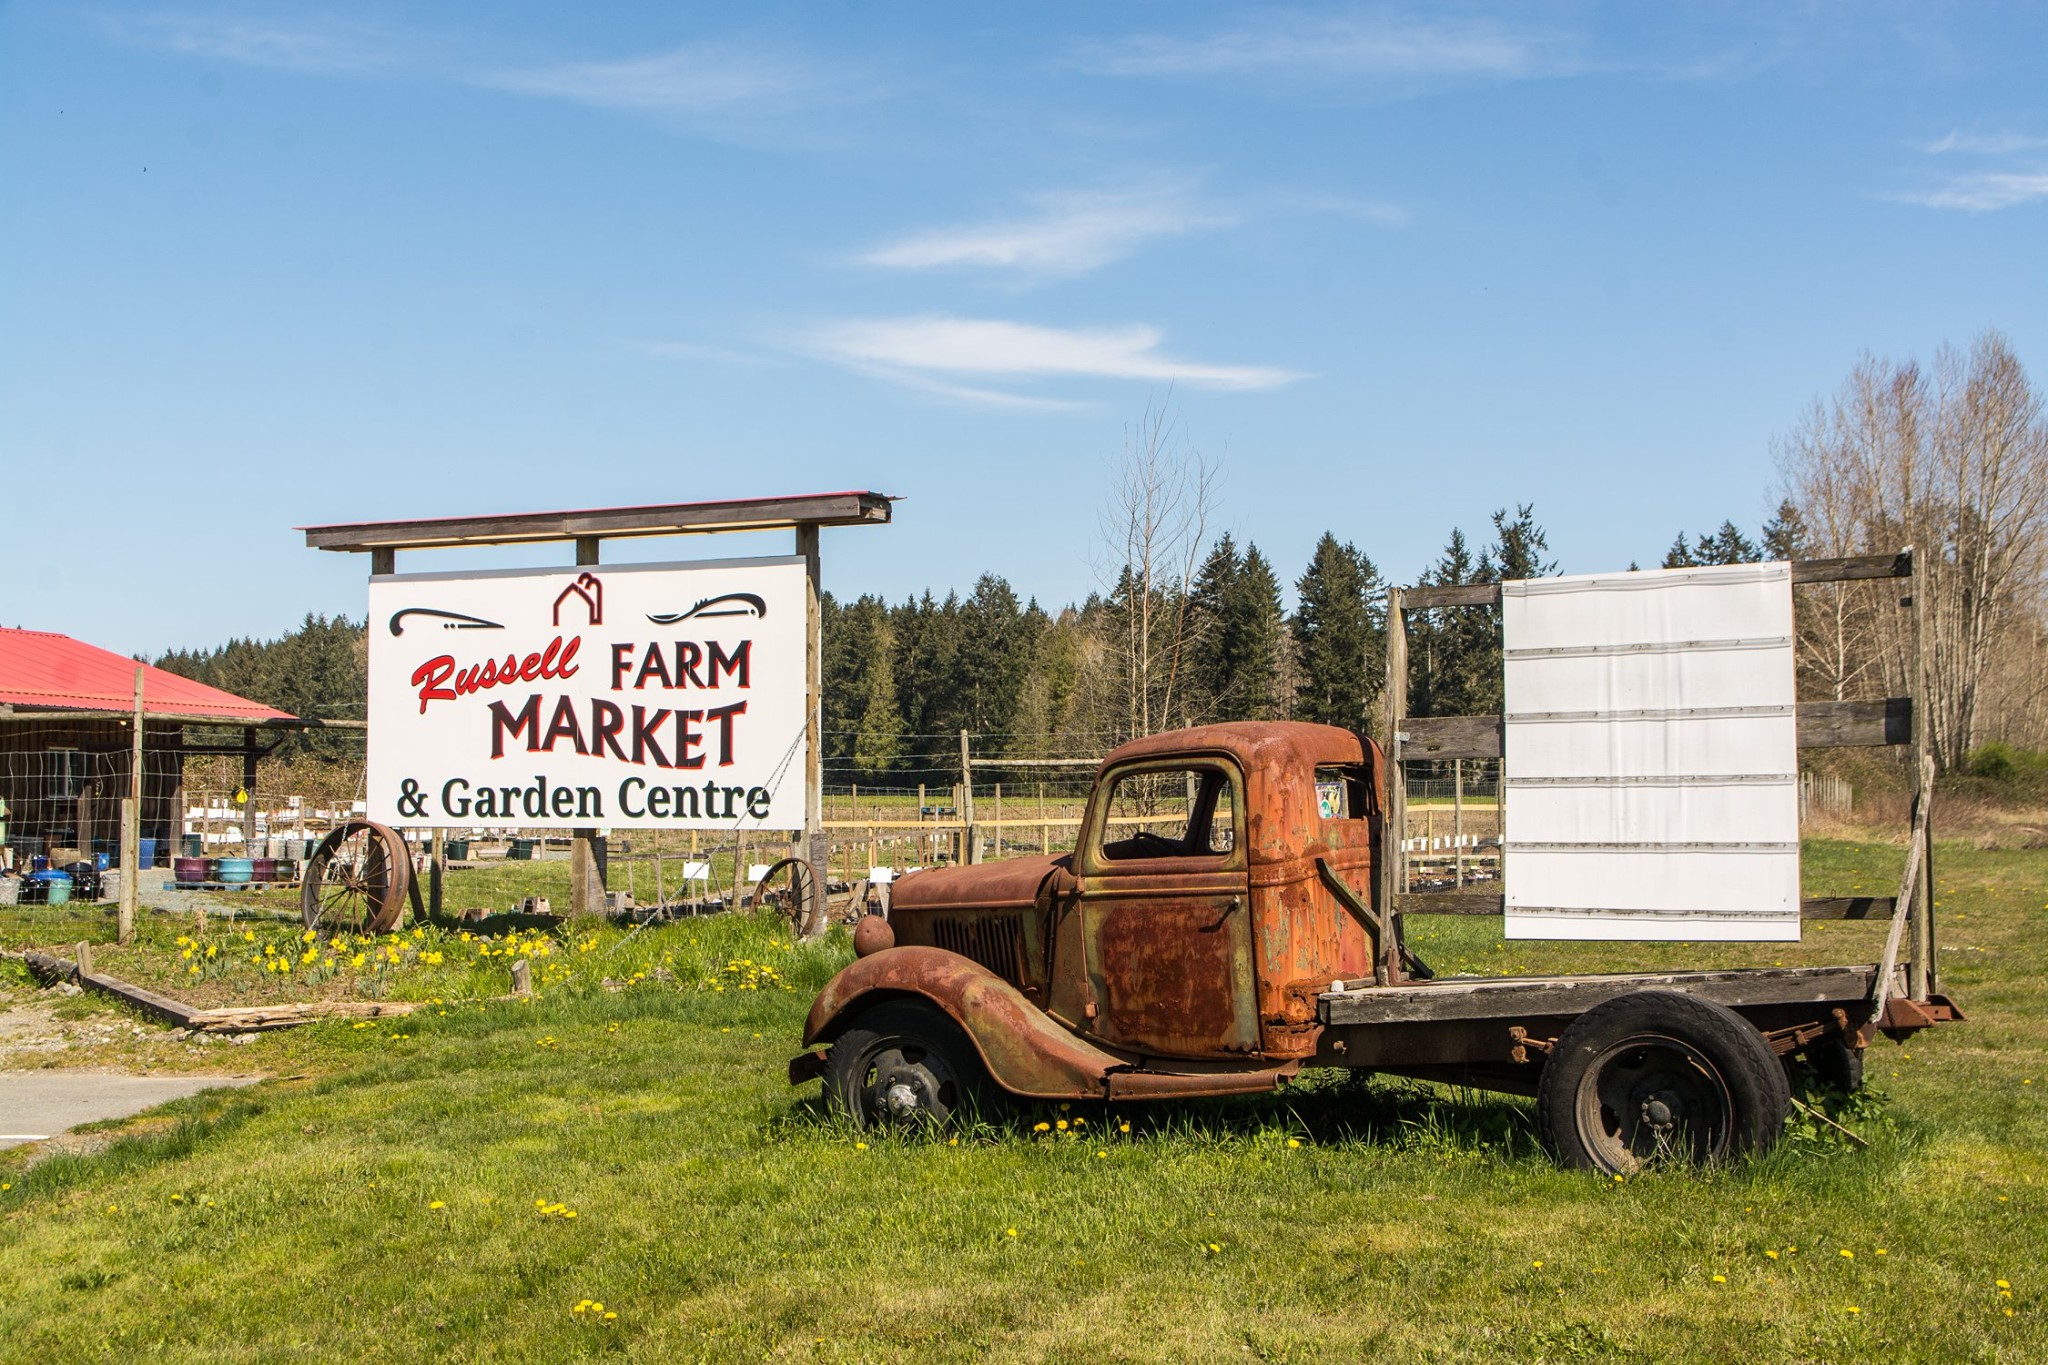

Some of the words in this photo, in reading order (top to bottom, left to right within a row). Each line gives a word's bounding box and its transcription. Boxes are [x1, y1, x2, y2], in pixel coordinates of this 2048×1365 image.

[411, 635, 581, 715] Russell
[611, 640, 753, 691] FARM
[487, 693, 748, 770] MARKET
[397, 777, 429, 819] &
[442, 775, 605, 819] Garden
[618, 776, 771, 819] Centre
